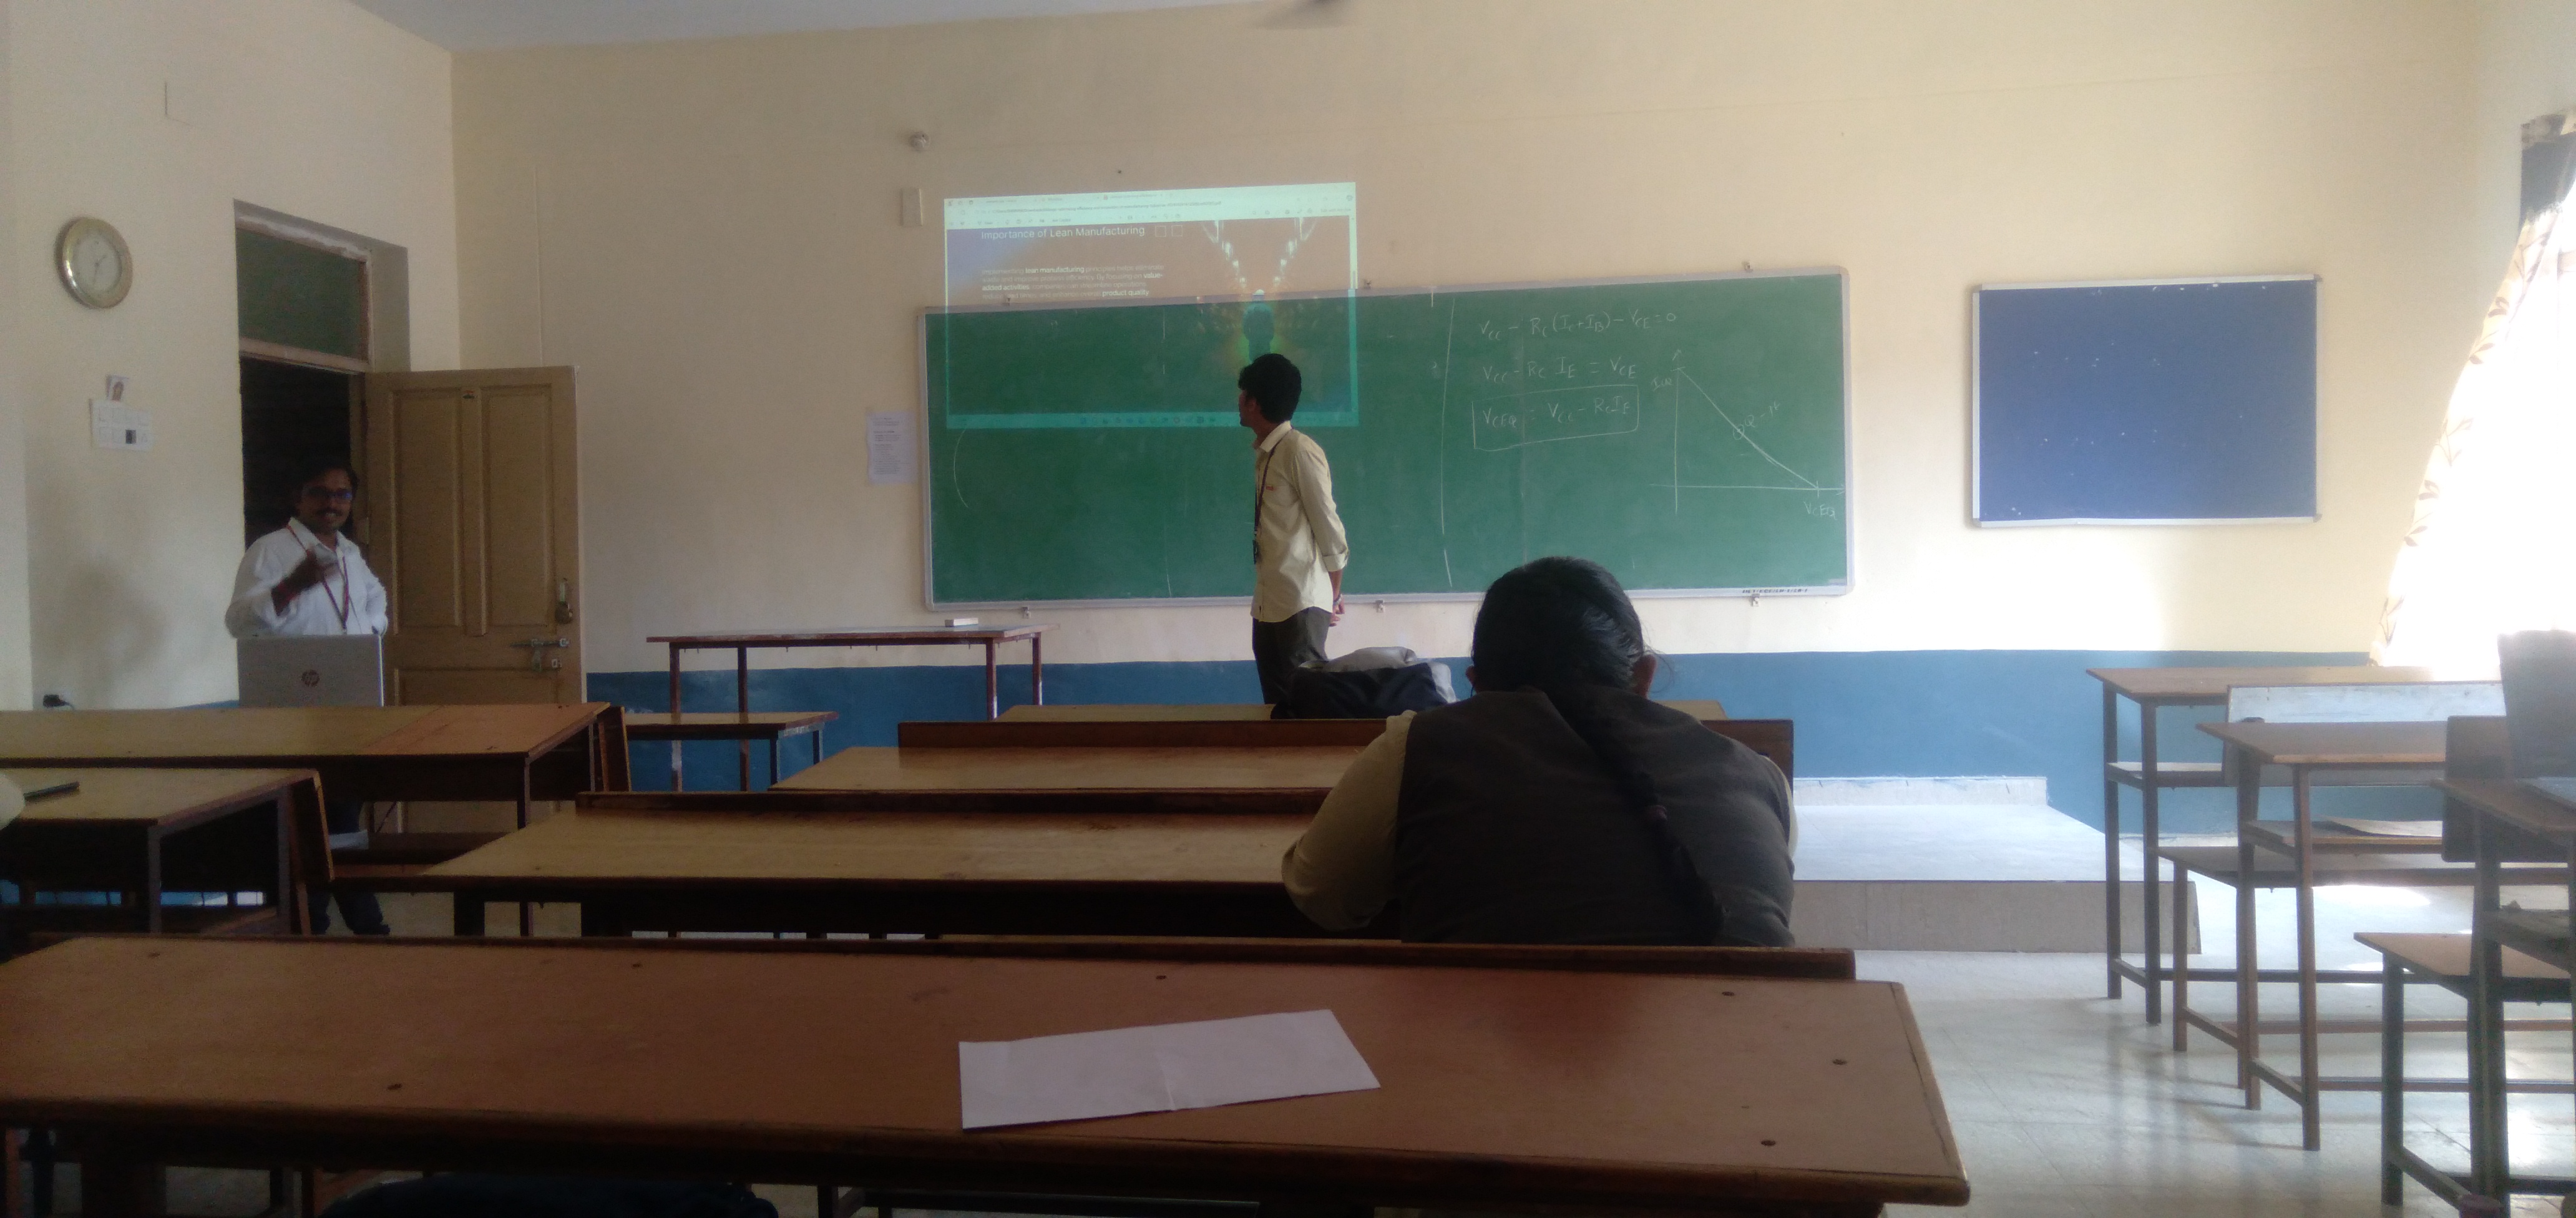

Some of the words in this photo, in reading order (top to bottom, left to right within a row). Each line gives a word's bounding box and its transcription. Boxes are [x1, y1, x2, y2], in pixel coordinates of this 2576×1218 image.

[981, 229, 1035, 240] Importance
[1038, 228, 1046, 238] of
[1050, 227, 1073, 238] Lean
[1076, 225, 1146, 238] Manufacturing
[1040, 266, 1085, 274] manufacturing
